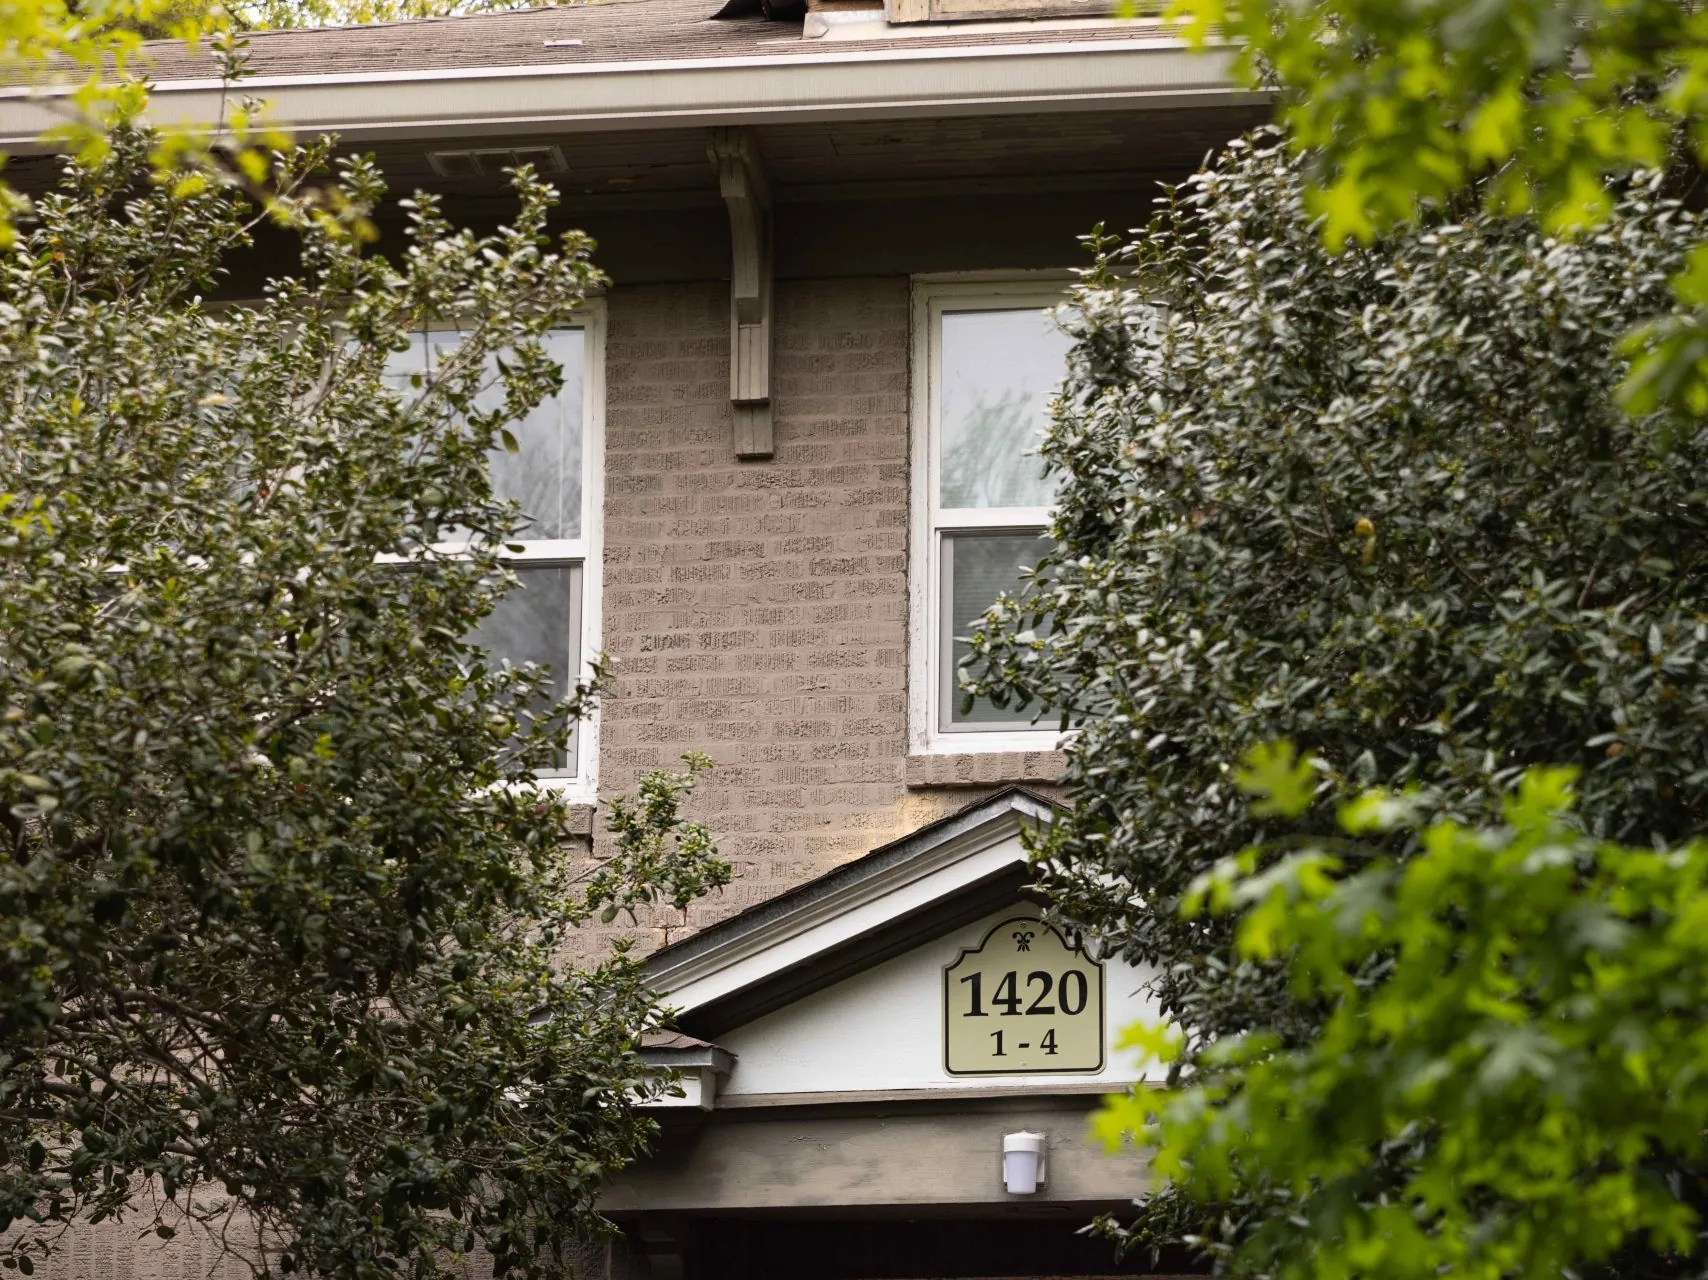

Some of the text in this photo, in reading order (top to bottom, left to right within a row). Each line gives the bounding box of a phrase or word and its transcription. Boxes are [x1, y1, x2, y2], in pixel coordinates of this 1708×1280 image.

[960, 970, 1088, 1017] 1420
[990, 1029, 1007, 1056] 1
[1040, 1029, 1058, 1055] 4
